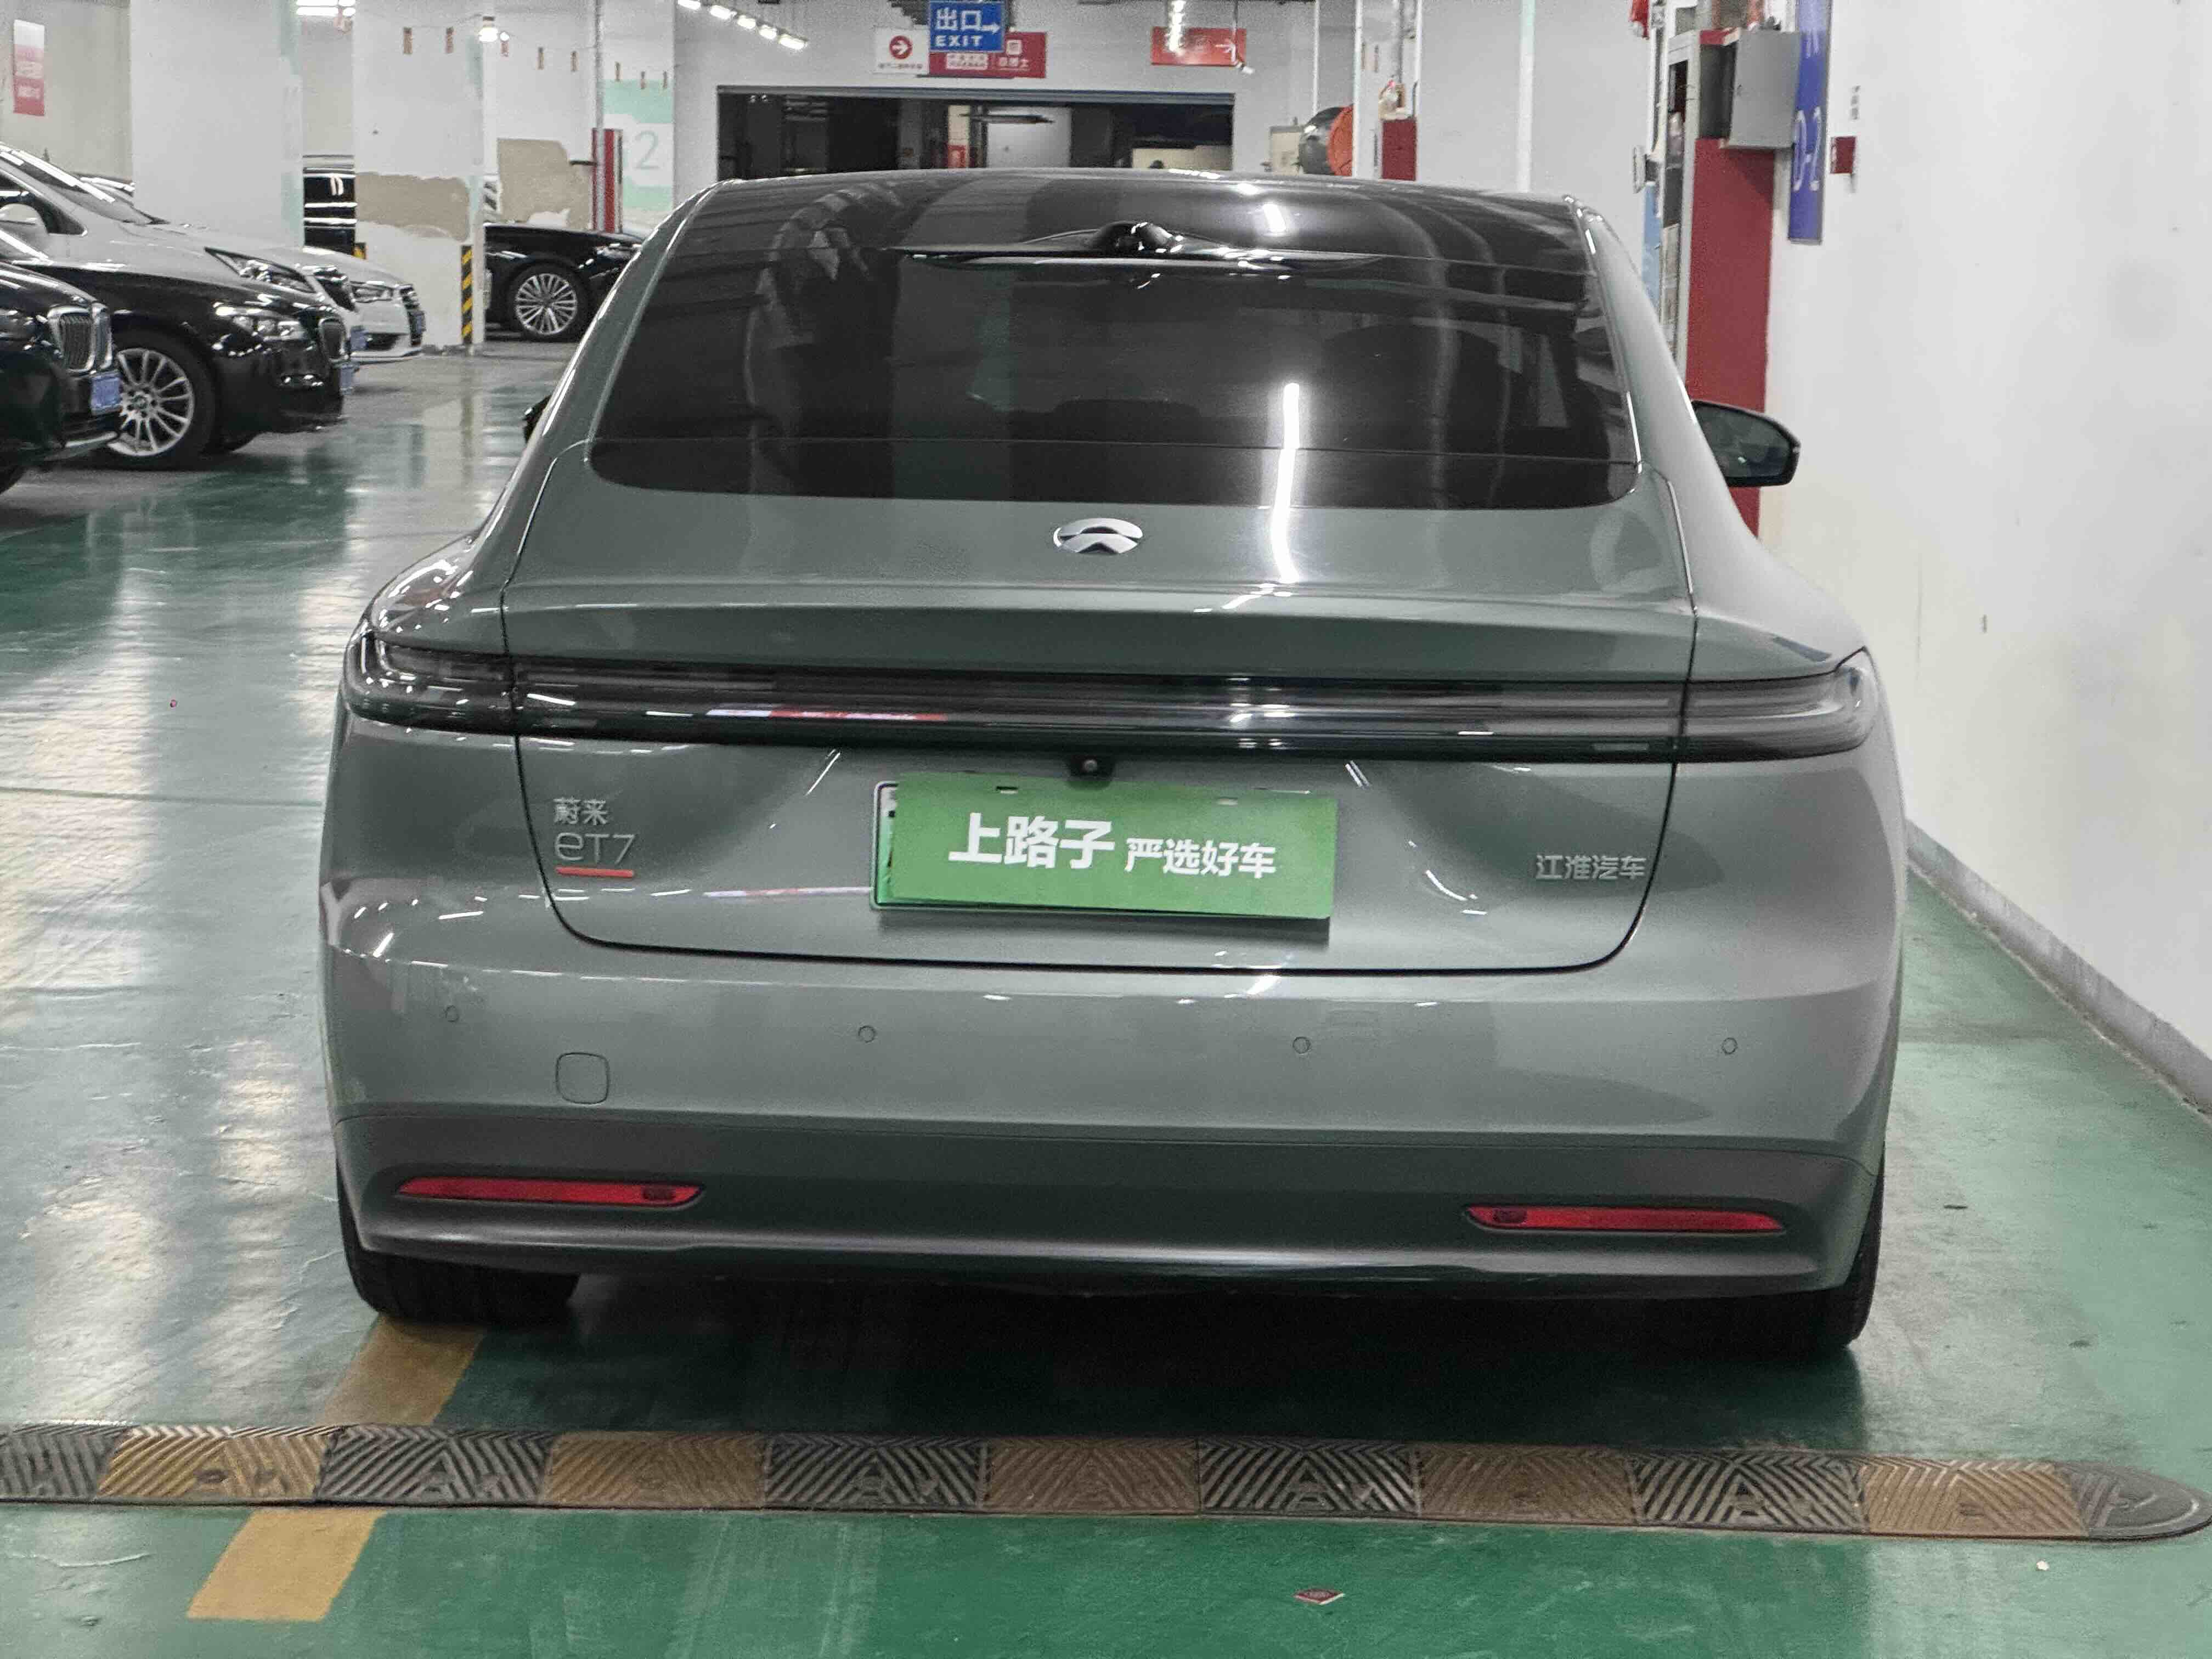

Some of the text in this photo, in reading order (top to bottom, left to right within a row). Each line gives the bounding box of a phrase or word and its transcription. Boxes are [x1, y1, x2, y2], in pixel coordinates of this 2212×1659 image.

[936, 7, 983, 31] 出口
[935, 35, 983, 47] EXIT
[636, 131, 660, 170] 2
[553, 797, 608, 825] 蔚来
[948, 811, 1277, 879] 上路子 严选好车
[1536, 854, 1646, 880] 江淮汽车
